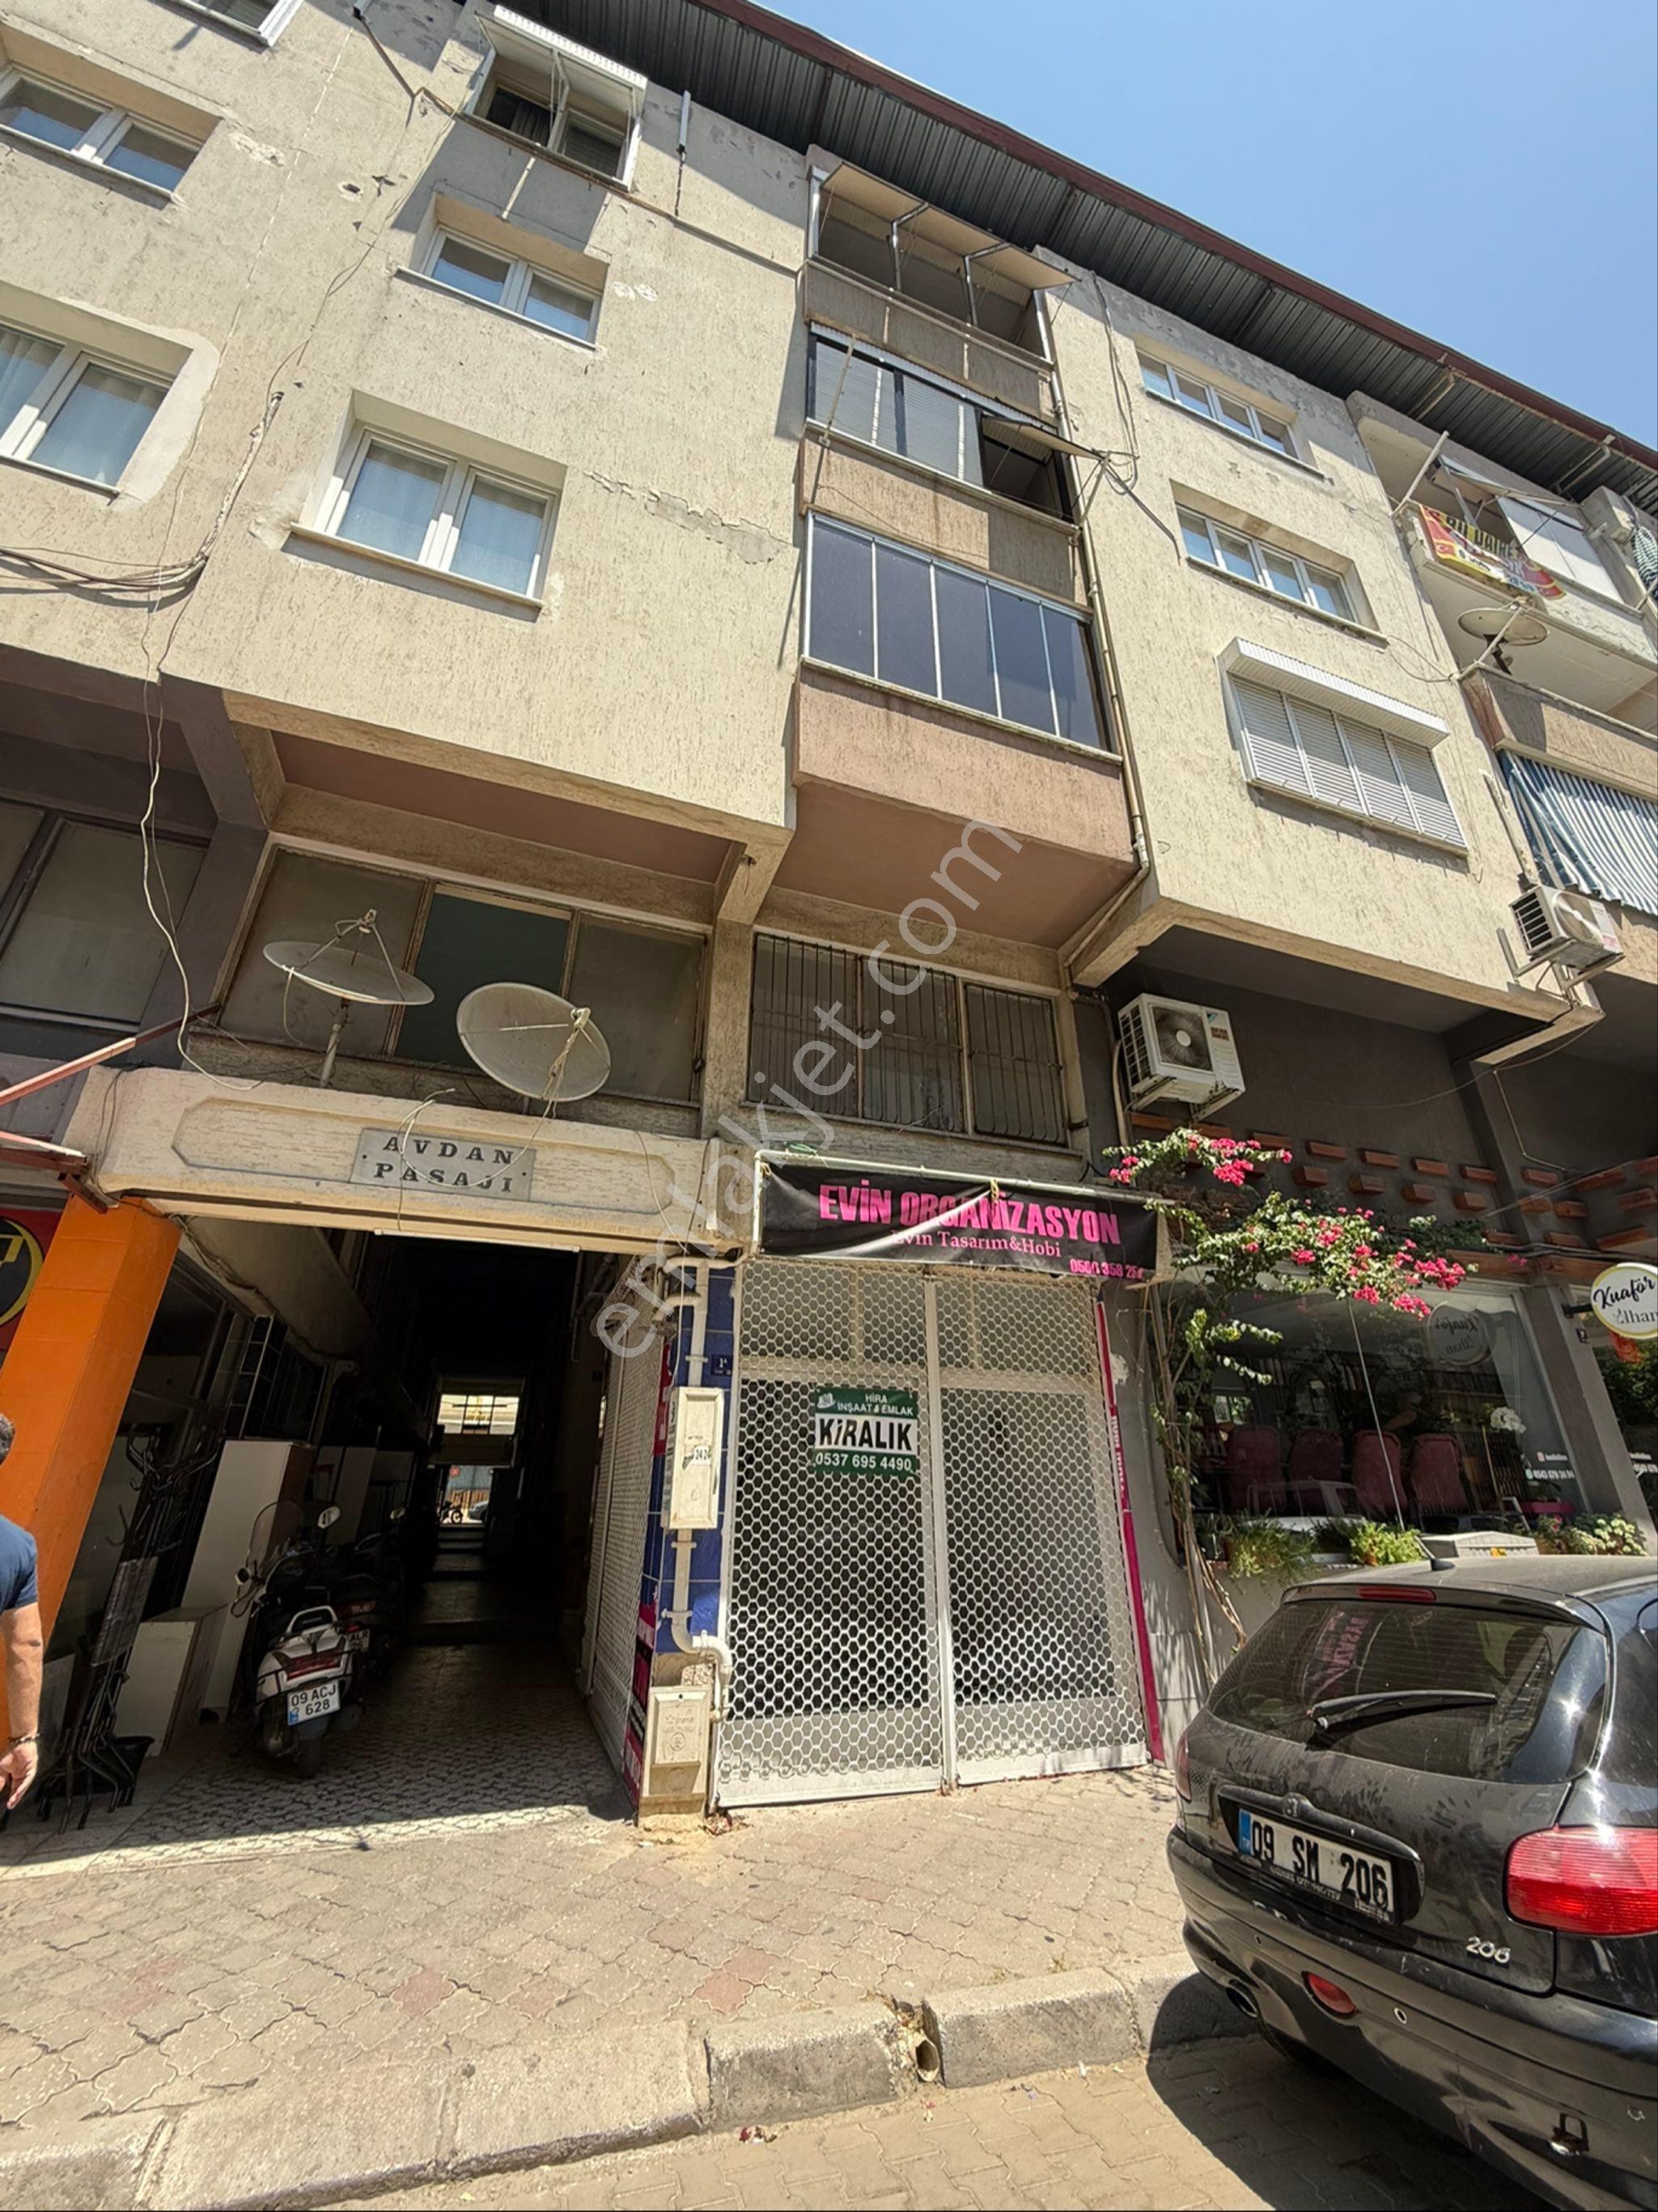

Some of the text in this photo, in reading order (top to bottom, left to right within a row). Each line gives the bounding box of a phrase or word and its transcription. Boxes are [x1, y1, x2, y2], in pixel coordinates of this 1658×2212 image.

[383, 1136, 514, 1165] AVDAN
[374, 1162, 513, 1192] PASAJI
[820, 1179, 892, 1225] EVİN
[1593, 1276, 1656, 1310] Kuaför
[865, 1392, 888, 1403] HİRA
[881, 1404, 914, 1416] EMLAK
[815, 1453, 912, 1471] 0537 695 4490
[291, 1683, 337, 1707] 09 ACJ
[305, 1699, 330, 1716] 628
[1252, 1819, 1274, 1863] 09
[1291, 1835, 1320, 1885] SM
[1339, 1852, 1389, 1911] 206
[1466, 1935, 1512, 1964] 206
